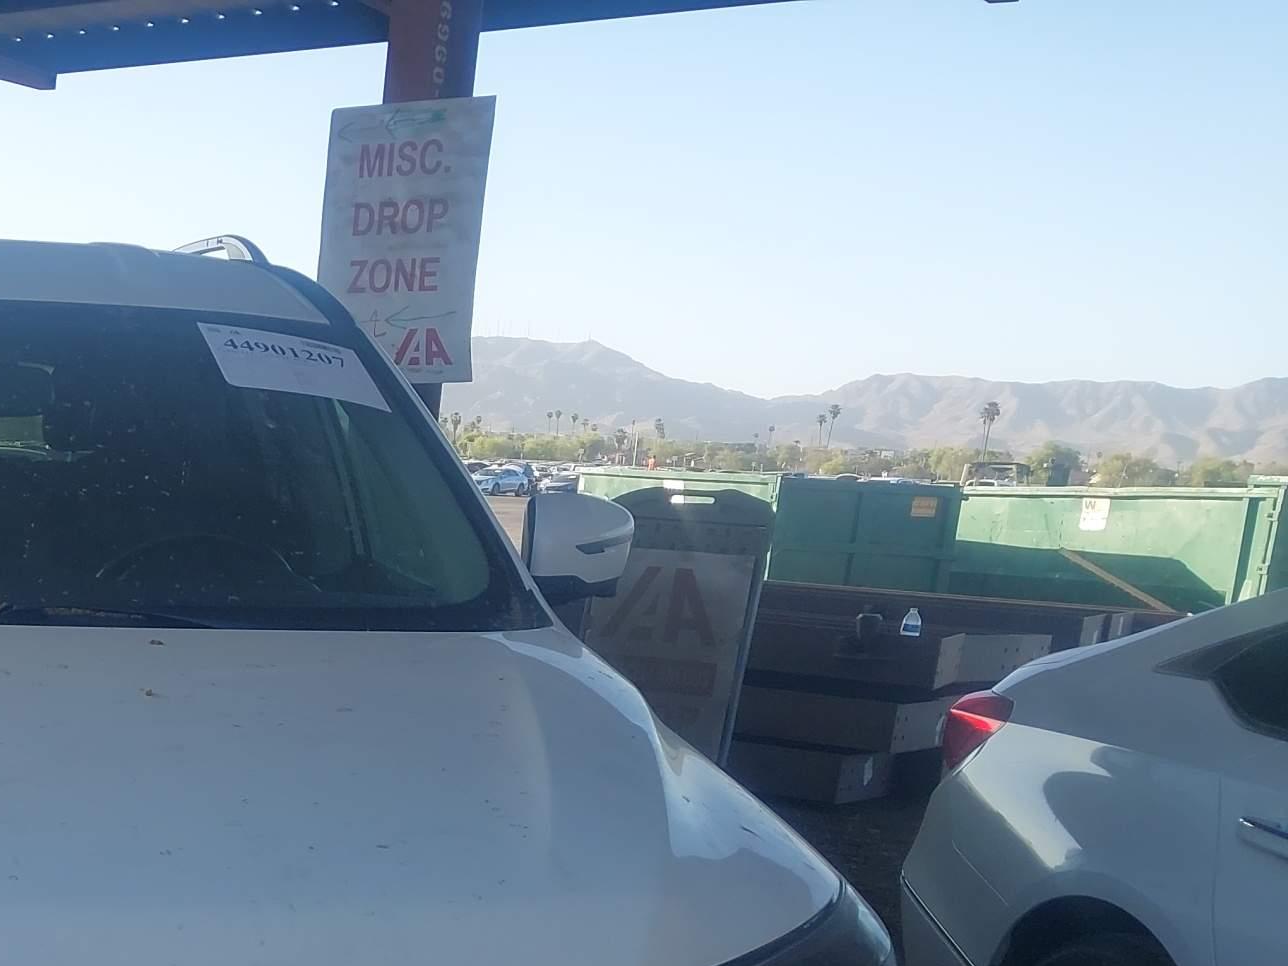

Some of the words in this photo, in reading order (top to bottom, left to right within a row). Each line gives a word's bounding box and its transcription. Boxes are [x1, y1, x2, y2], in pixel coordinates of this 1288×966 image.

[358, 138, 452, 179] MISC.
[351, 199, 449, 237] DROP
[347, 256, 441, 294] ZONE
[223, 338, 344, 368] 44901207
